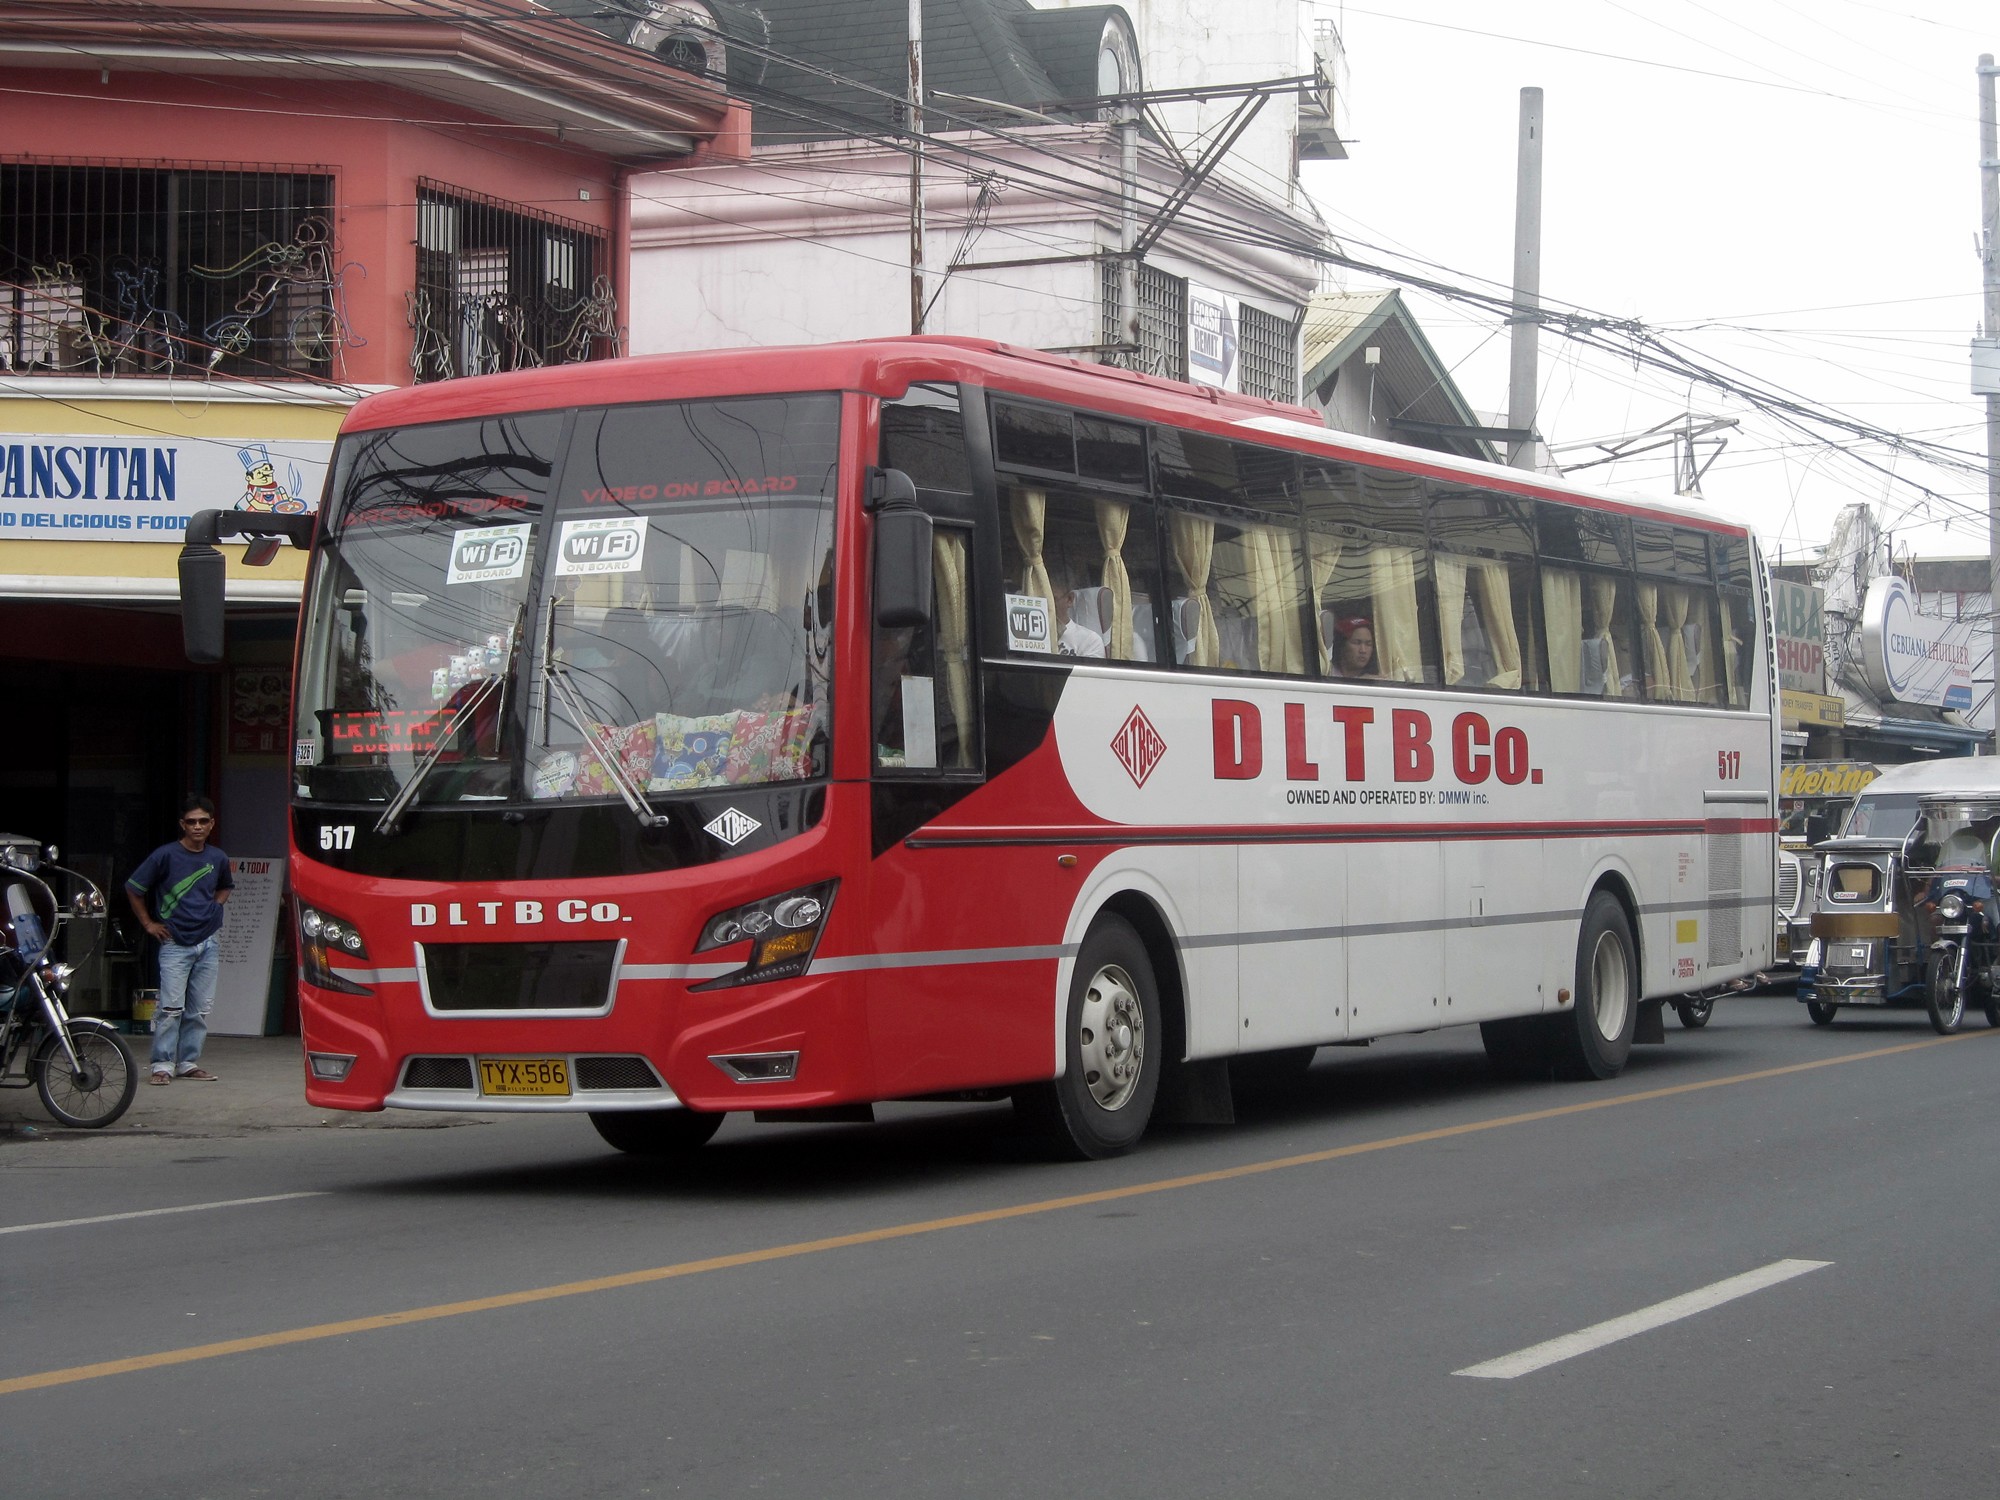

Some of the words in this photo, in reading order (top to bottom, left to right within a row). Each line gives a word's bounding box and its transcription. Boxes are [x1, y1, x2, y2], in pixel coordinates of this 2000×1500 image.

[1193, 300, 1221, 333] GCASH
[1194, 327, 1219, 358] REMIT
[581, 484, 658, 504] VIDEO
[664, 481, 699, 498] ON
[704, 475, 798, 496] BOARD
[21, 513, 131, 529] DELICIOUS
[137, 515, 192, 530] FOOD
[573, 519, 636, 531] FREE
[464, 526, 521, 539] FREE
[462, 541, 517, 564] WiFi
[571, 534, 632, 555] WiFi
[456, 570, 473, 581] ON
[475, 567, 513, 579] BOARD
[566, 563, 586, 573] ON
[588, 561, 630, 572] BOARD
[1010, 597, 1042, 607] FREE
[1012, 613, 1043, 633] WiFi
[1014, 640, 1024, 648] ON
[1025, 641, 1046, 650] BOARD
[1891, 633, 1927, 658] CEBUANA
[1928, 640, 1970, 666] LHUILLIER
[1777, 638, 1823, 674] SHOP
[1718, 750, 1741, 780] 517
[1286, 789, 1330, 805] OWNED
[1332, 790, 1356, 805] AND
[1359, 790, 1417, 805] OPERATED
[1419, 790, 1436, 805] BY:
[1438, 790, 1471, 805] DMMW
[1473, 790, 1490, 805] inc.
[319, 825, 356, 850] 517
[239, 861, 246, 873] 4
[246, 862, 270, 874] TODAY
